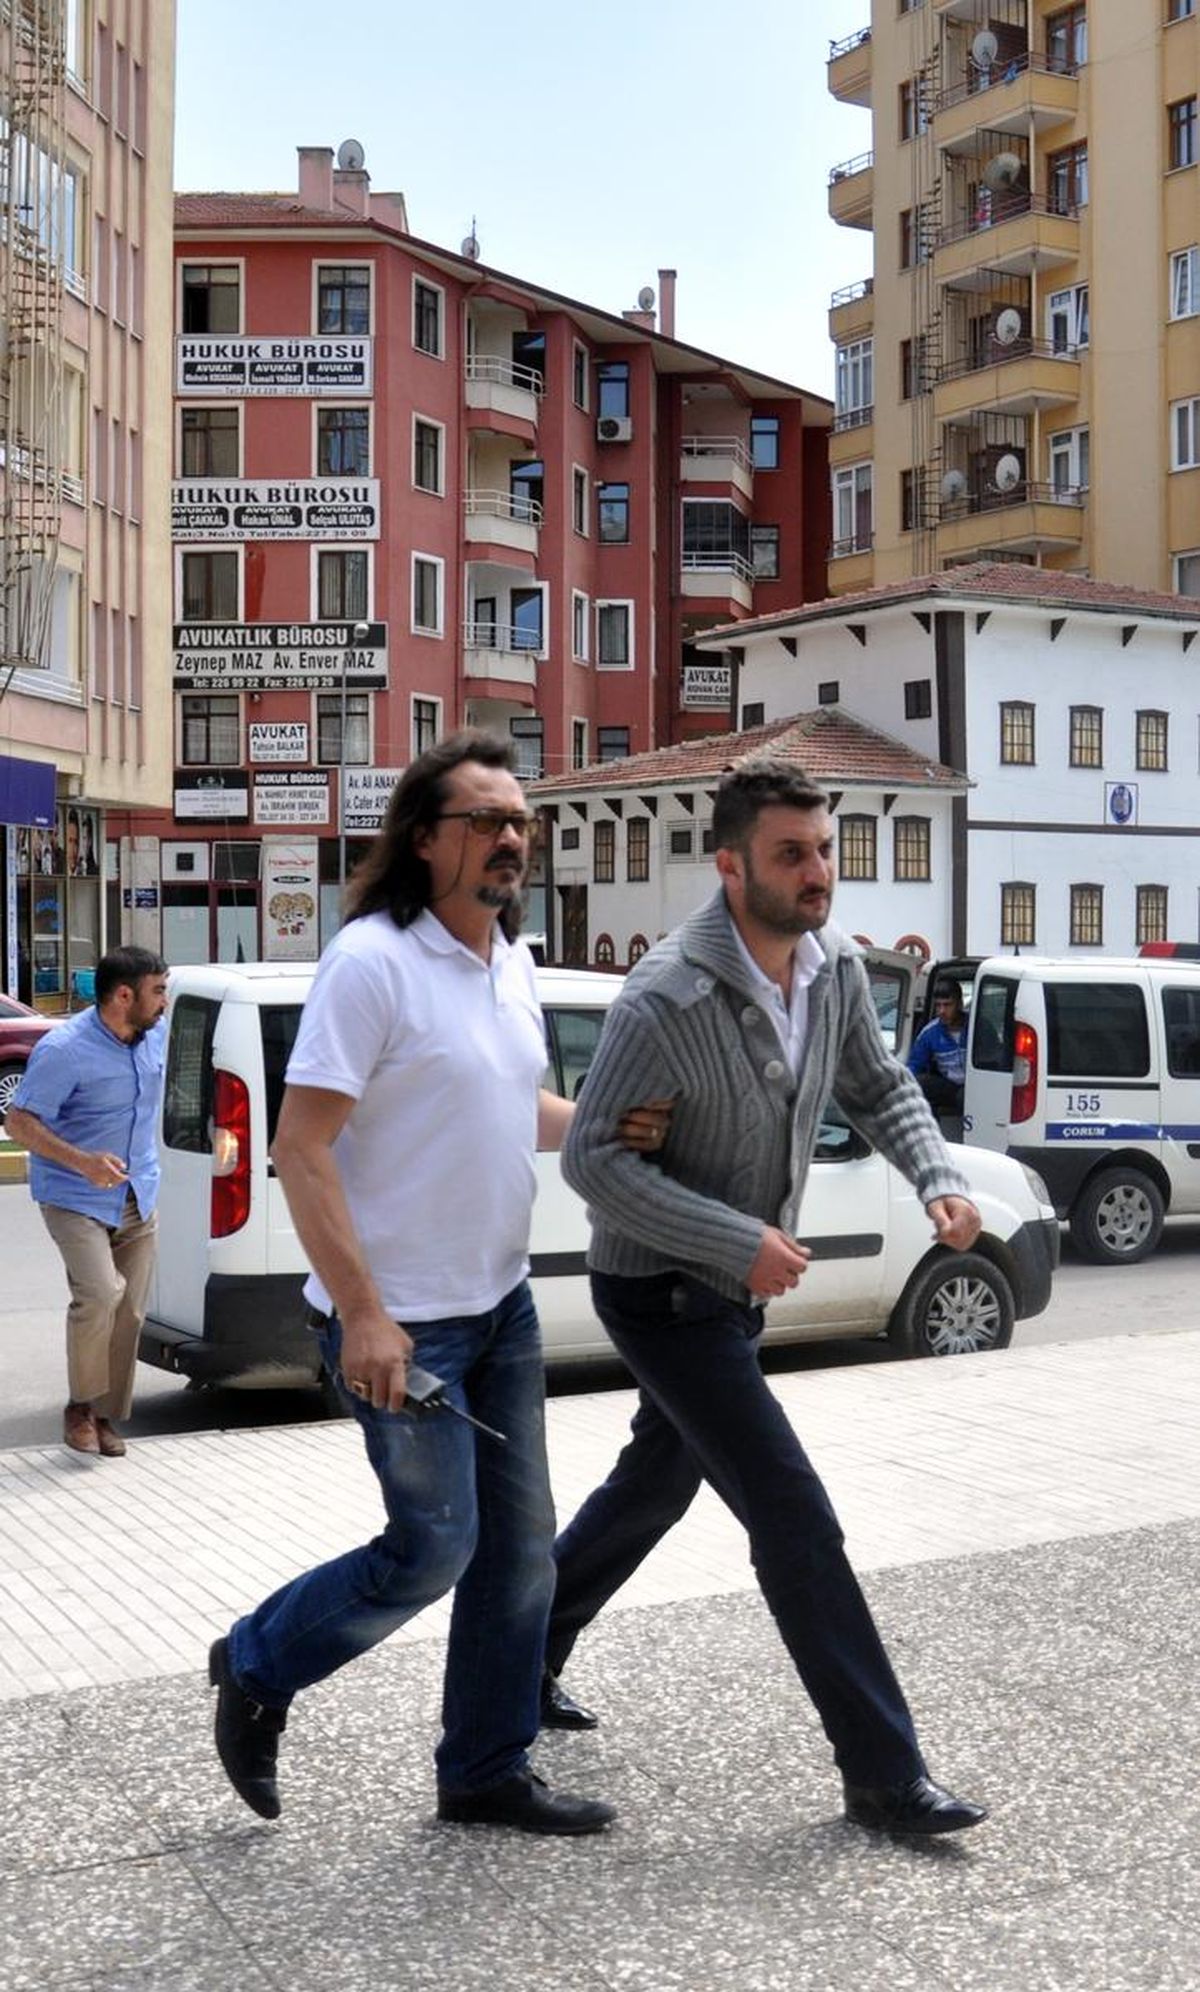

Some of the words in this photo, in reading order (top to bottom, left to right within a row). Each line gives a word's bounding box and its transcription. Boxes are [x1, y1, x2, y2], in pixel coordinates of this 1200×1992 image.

[182, 344, 261, 358] HUKUK
[271, 340, 364, 358] BÜROSU
[196, 364, 233, 373] AVUKAT
[255, 364, 298, 373] AVUKAT
[317, 364, 354, 373] AVUKAT
[172, 488, 260, 503] HUKUK
[267, 482, 369, 503] BÜROSU
[178, 628, 272, 646] AVUKATLIK
[277, 626, 348, 646] BÜROSU
[176, 653, 226, 674] Zeynep
[231, 652, 263, 670] MAZ
[273, 652, 293, 669] Av.
[299, 652, 338, 669] Enver
[344, 651, 376, 669] MAZ
[688, 670, 729, 682] AVUKAT
[252, 726, 305, 738] AVUKAT
[255, 774, 288, 783] HUKUK
[290, 772, 327, 783] BÜROSU
[1067, 1094, 1101, 1111] 155
[1062, 1127, 1105, 1138] ÇORUM
